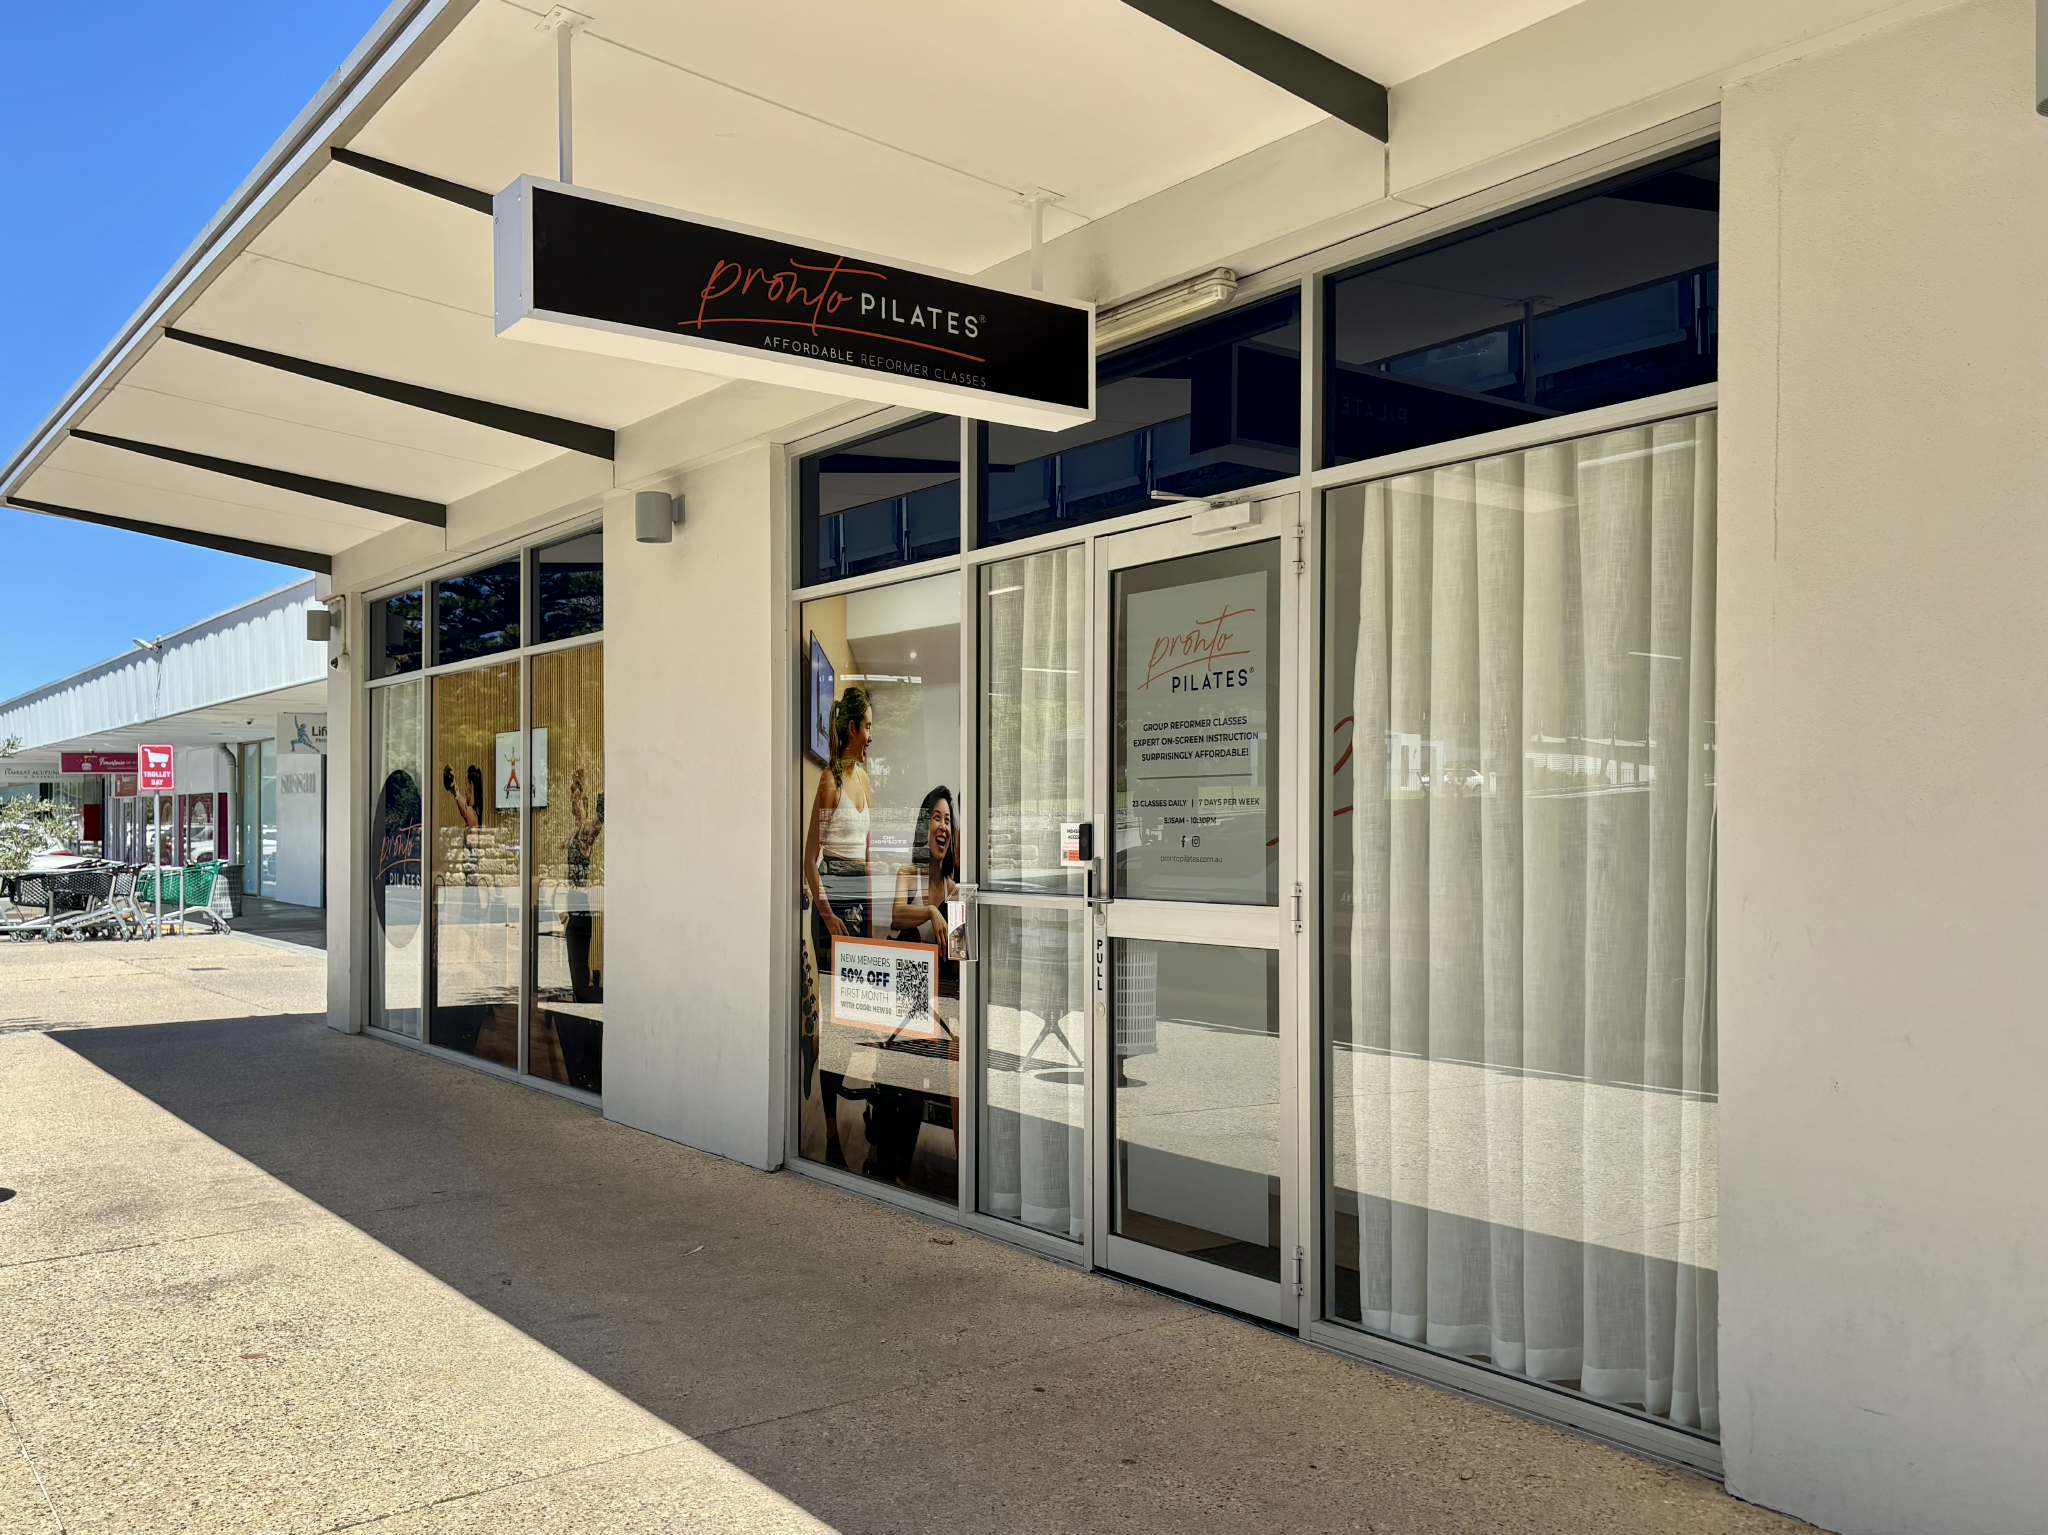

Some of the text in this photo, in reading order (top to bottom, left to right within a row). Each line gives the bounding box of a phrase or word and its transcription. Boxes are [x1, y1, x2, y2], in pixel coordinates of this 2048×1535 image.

[698, 256, 887, 337] pronto
[764, 336, 986, 388] AFFORDABLE REFORMER CLASSES
[1146, 604, 1255, 690] pronto
[1143, 716, 1248, 732] GROUP REFORMER CLASSES
[1133, 732, 1259, 747] EXPERT ON-SCREEN INSTRUCTION
[1142, 747, 1249, 762] SURPRISINGLY AFFORDABLE!
[1168, 799, 1187, 807] DAILY
[1223, 798, 1237, 806] PER
[1238, 798, 1260, 806] WEEK
[840, 953, 891, 968] NEW MEMBERS
[840, 967, 890, 987] 50% OFF
[840, 986, 889, 1003] FIRST MONTH
[840, 1000, 855, 1009] WITH
